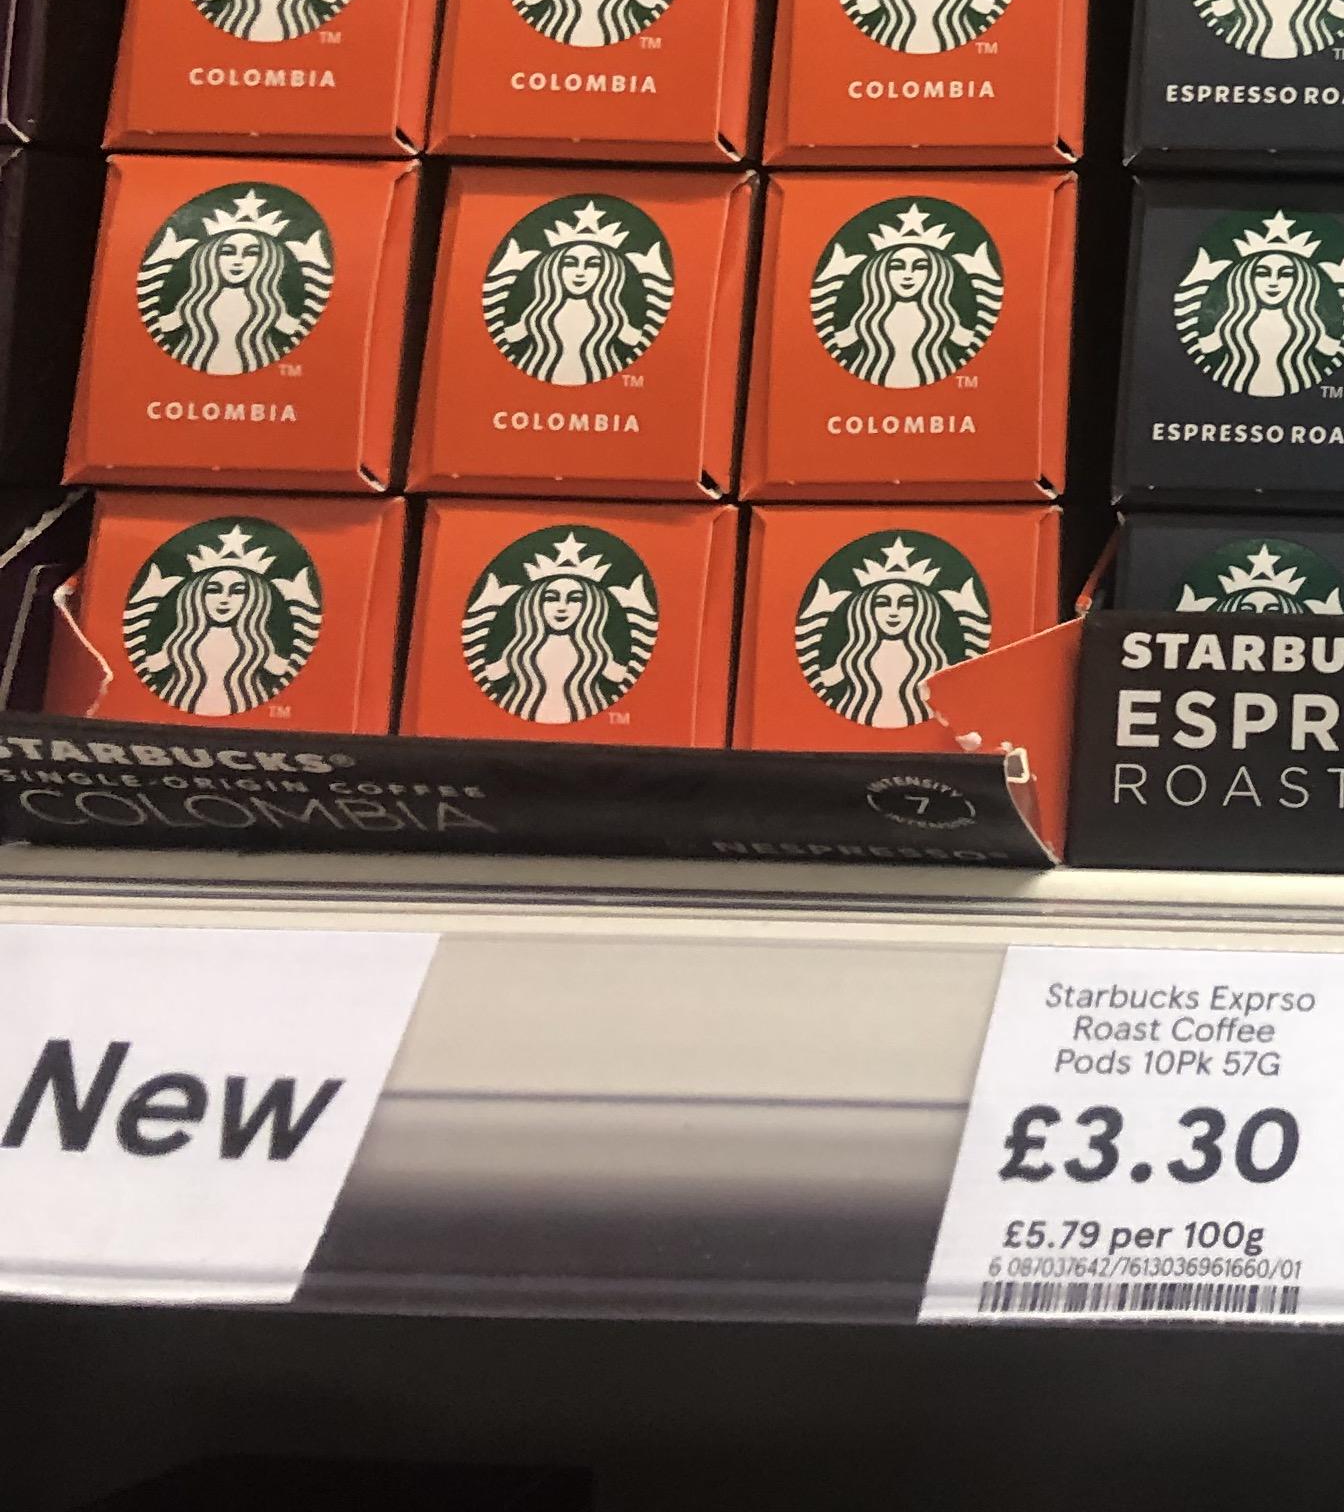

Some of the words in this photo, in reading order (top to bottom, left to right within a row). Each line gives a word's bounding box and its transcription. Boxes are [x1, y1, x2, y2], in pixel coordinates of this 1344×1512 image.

[189, 68, 335, 87] COLOMBIA
[511, 73, 656, 93] COLOMBIA
[848, 81, 994, 98] COLOMBIA
[1167, 85, 1297, 104] ESPRESSO
[147, 402, 296, 421] COLOMBIA
[493, 412, 639, 432] COLOMBIA
[828, 416, 975, 434] COLOMBIA
[1153, 423, 1284, 443] ESPRESSO
[20, 789, 498, 833] COLOMBIA
[1046, 983, 1199, 1009] Starbucks
[1210, 986, 1315, 1019] Exprso
[1073, 1016, 1160, 1041] Roast
[1172, 1014, 1275, 1043] Coffee
[1055, 1049, 1130, 1074] Pods
[1146, 1051, 1212, 1075] 10Pk
[1223, 1051, 1280, 1076] 57G
[0, 1040, 343, 1161] New
[998, 1105, 1299, 1183] £3.30
[1002, 1220, 1101, 1249] £5.79
[1108, 1226, 1173, 1255] per
[1183, 1221, 1265, 1256] 100g
[989, 1256, 1001, 1276] 6
